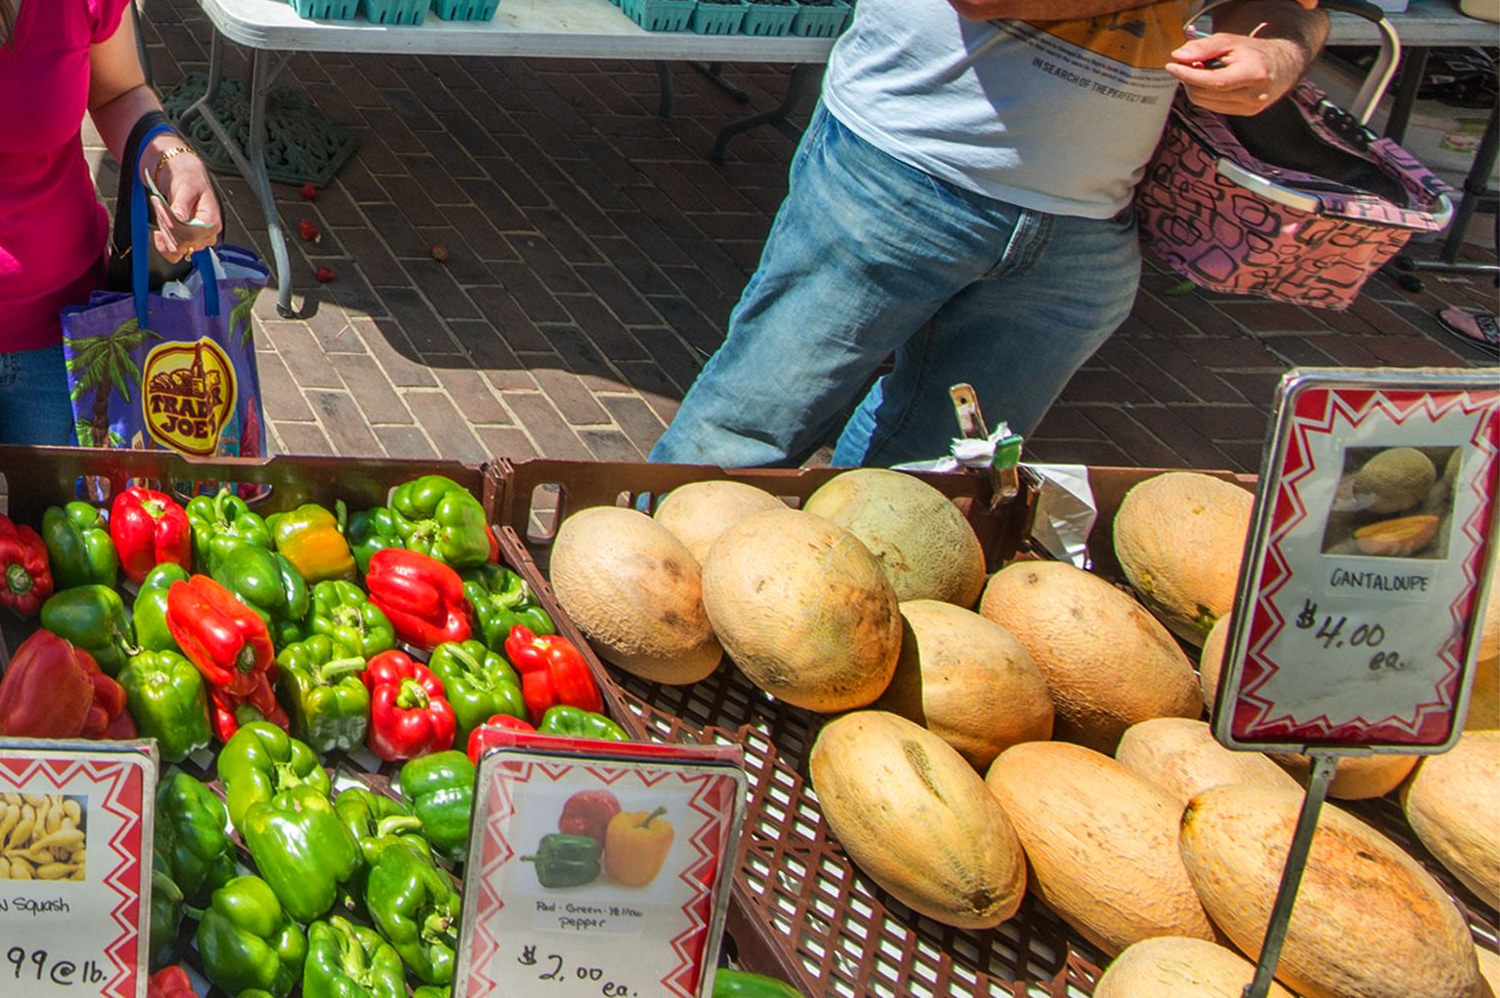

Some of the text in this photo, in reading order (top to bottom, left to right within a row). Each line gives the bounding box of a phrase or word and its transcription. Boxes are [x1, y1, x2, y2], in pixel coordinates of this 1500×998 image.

[1031, 56, 1043, 68] IN
[1041, 60, 1080, 86] SEARCH
[1078, 76, 1092, 89] OF
[1092, 82, 1108, 96] THE
[1106, 86, 1142, 103] PERFECT
[150, 386, 223, 420] TRADR
[160, 414, 217, 439] JOE
[1296, 598, 1385, 649] $4.00
[1368, 650, 1405, 671] ea.
[12, 896, 70, 916] Squash
[517, 945, 603, 982] $2.00
[602, 981, 639, 998] ea.
